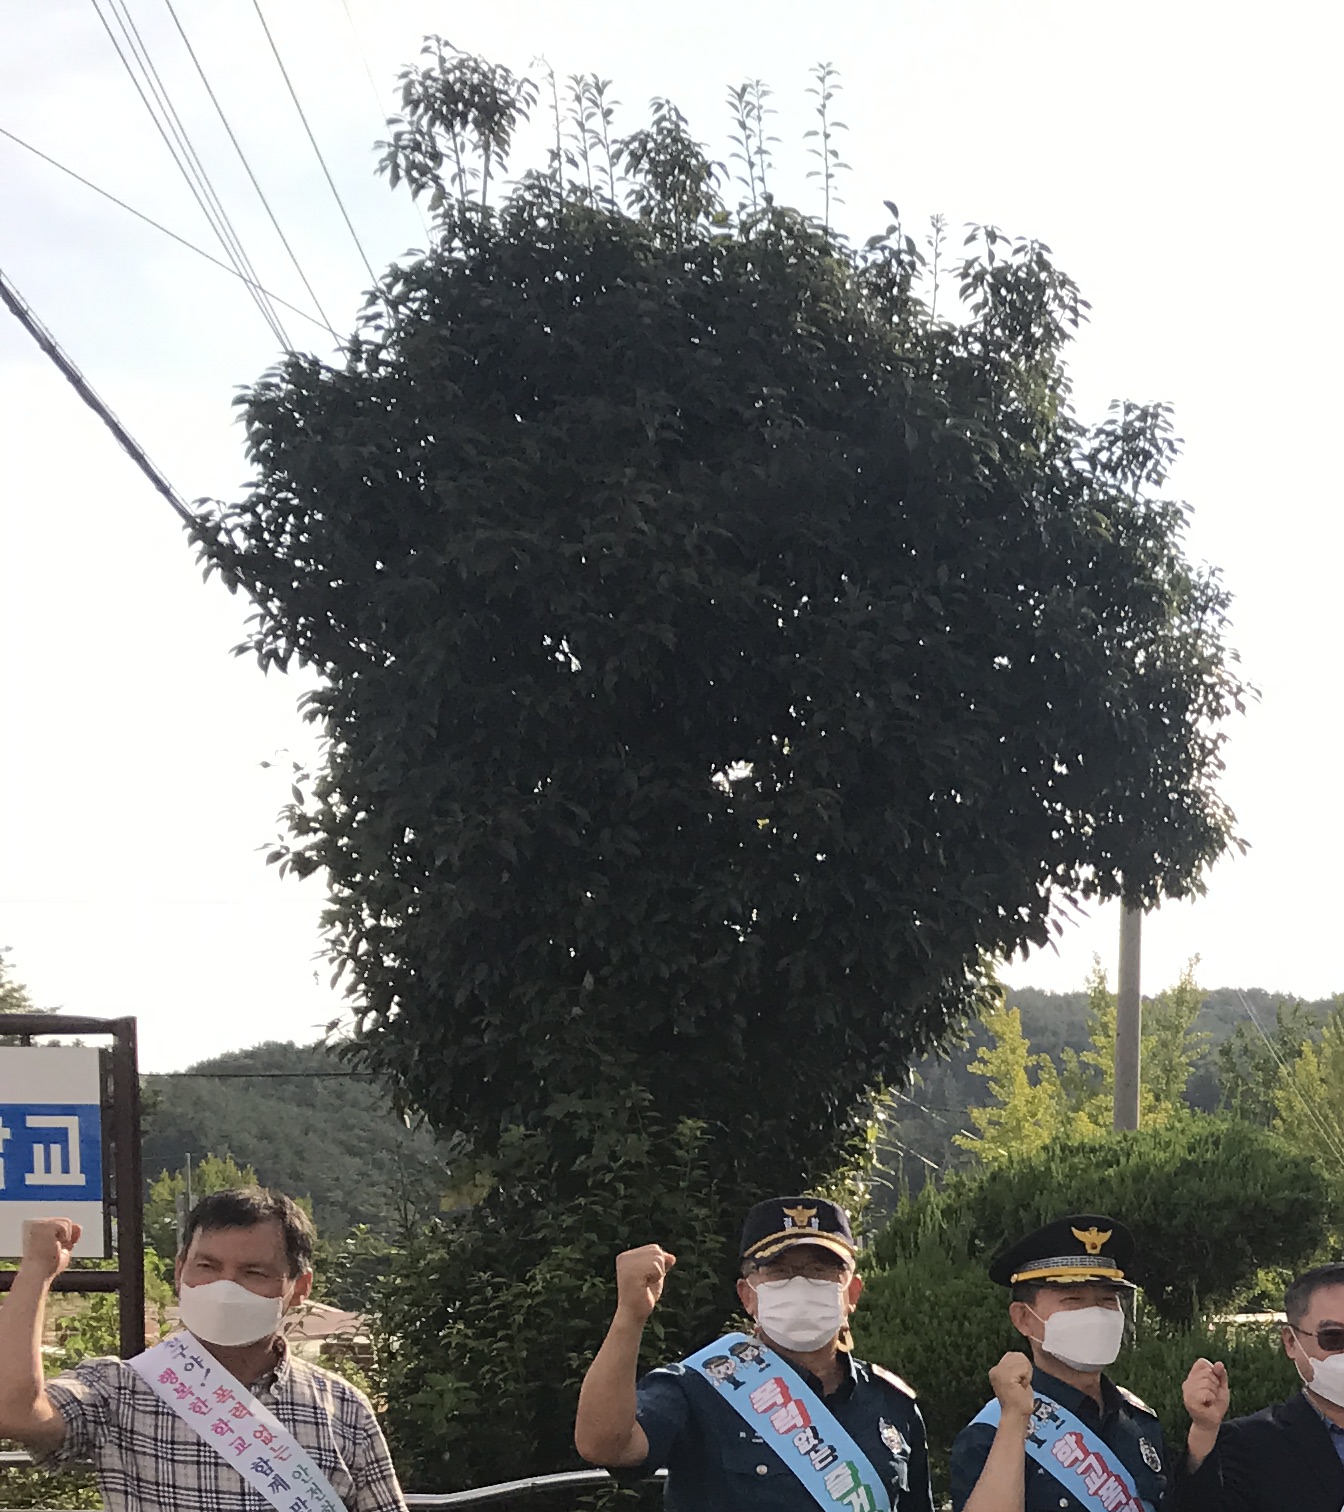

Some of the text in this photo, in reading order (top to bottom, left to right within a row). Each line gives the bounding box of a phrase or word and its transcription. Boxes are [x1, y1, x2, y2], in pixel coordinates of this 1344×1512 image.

[157, 1367, 213, 1416] 행복한
[210, 1418, 252, 1456] 학교
[250, 1456, 291, 1495] 함께
[212, 1384, 256, 1420] 폭력
[253, 1424, 292, 1462] 없는
